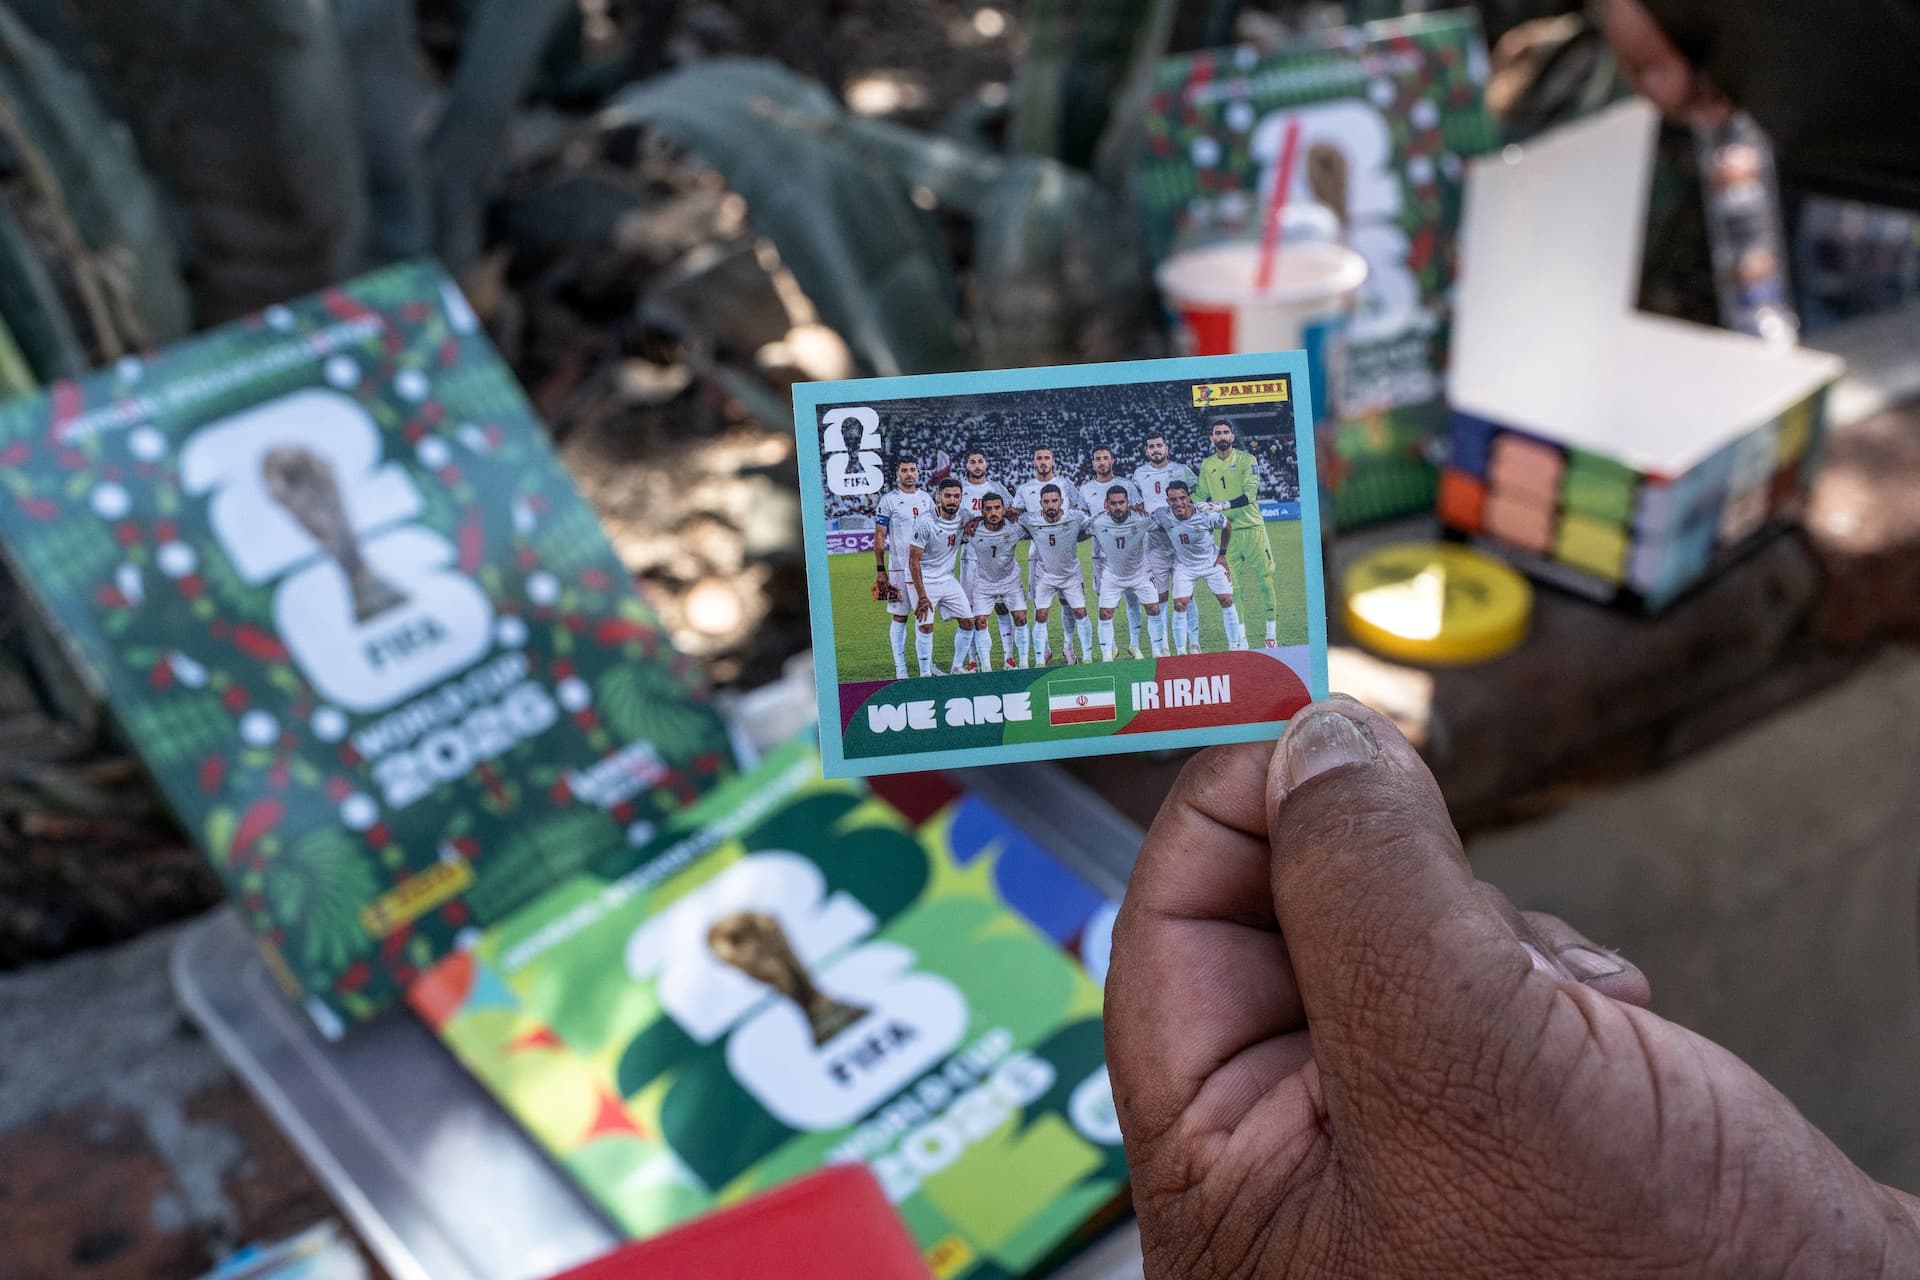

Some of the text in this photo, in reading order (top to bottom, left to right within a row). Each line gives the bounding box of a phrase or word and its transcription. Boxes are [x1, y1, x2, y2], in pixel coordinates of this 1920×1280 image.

[1219, 382, 1284, 396] PANINI
[843, 477, 870, 488] FIFA
[1154, 481, 1161, 494] 6
[1220, 475, 1226, 489] 1
[1049, 534, 1056, 547] 5
[1115, 537, 1125, 550] 17
[991, 545, 997, 558] 7
[867, 700, 937, 734] WE
[1130, 682, 1159, 712] IR
[1163, 674, 1231, 709] IRAN
[826, 1019, 915, 1086] FIFA
